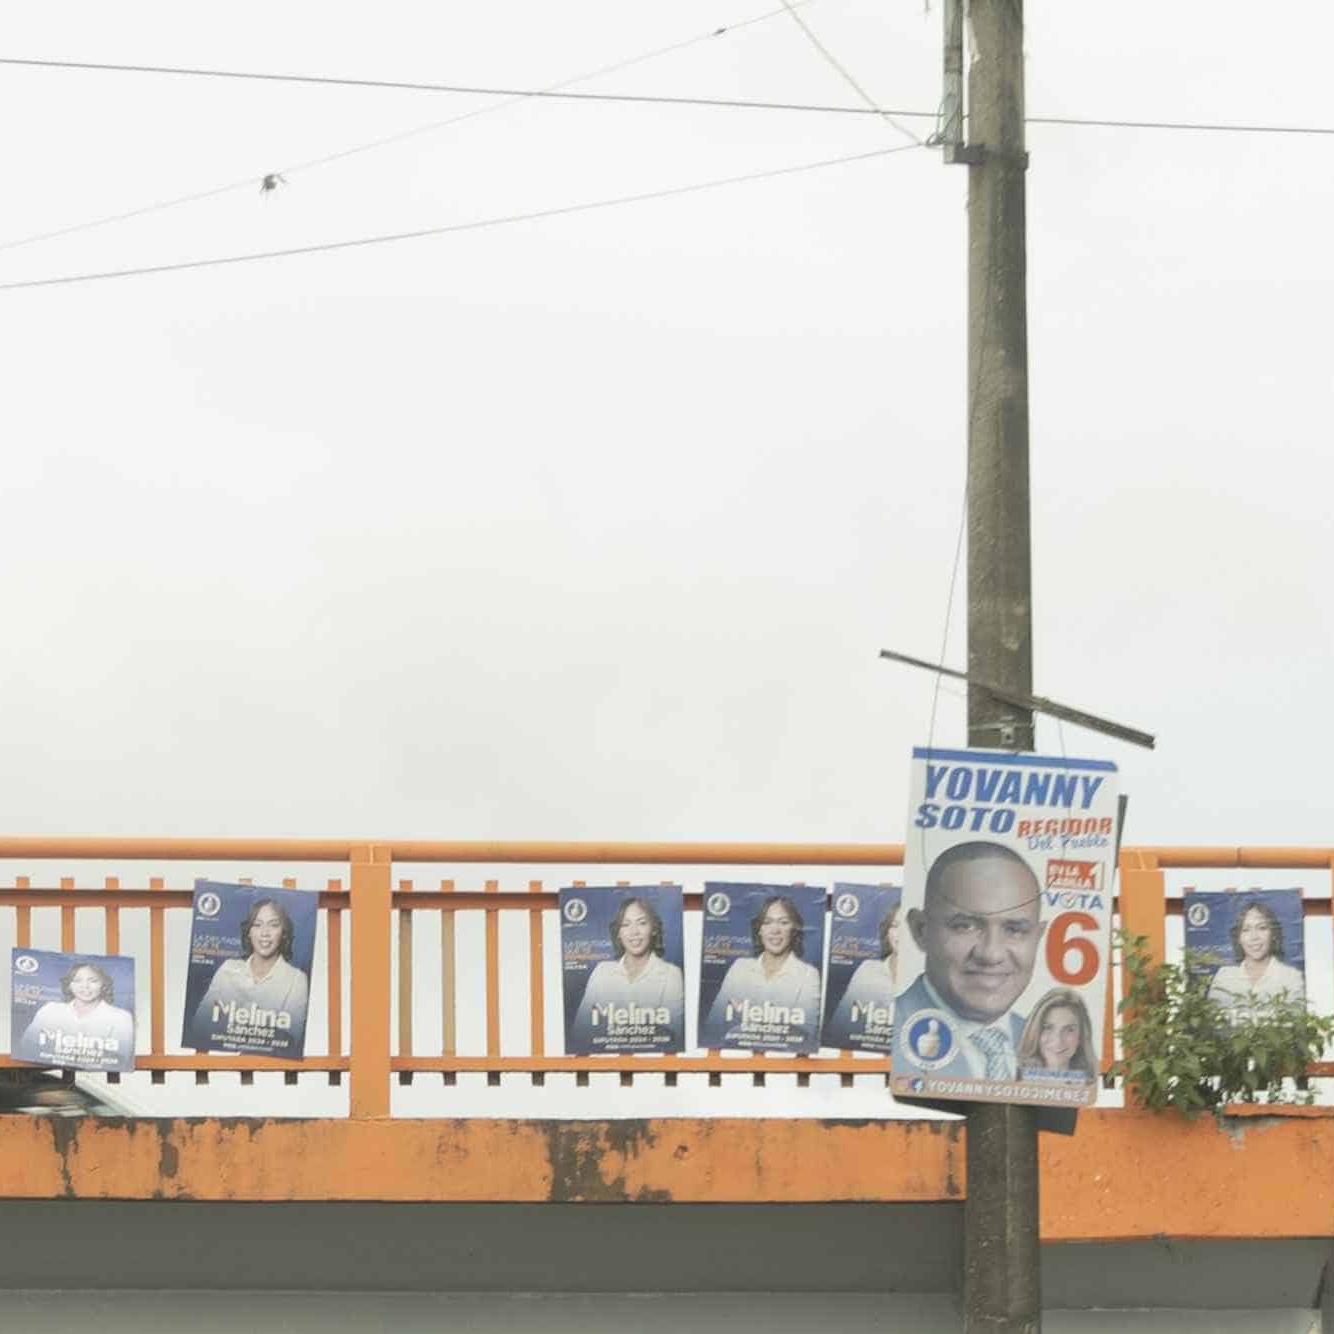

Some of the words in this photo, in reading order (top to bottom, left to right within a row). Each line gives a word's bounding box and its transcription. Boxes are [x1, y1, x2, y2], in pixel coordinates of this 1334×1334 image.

[925, 765, 1104, 810] YOVANNY
[915, 803, 1017, 834] SOTO
[1045, 911, 1100, 986] 6
[211, 1000, 292, 1030] Melina
[592, 1002, 671, 1026] Melina
[725, 999, 806, 1025] Melina
